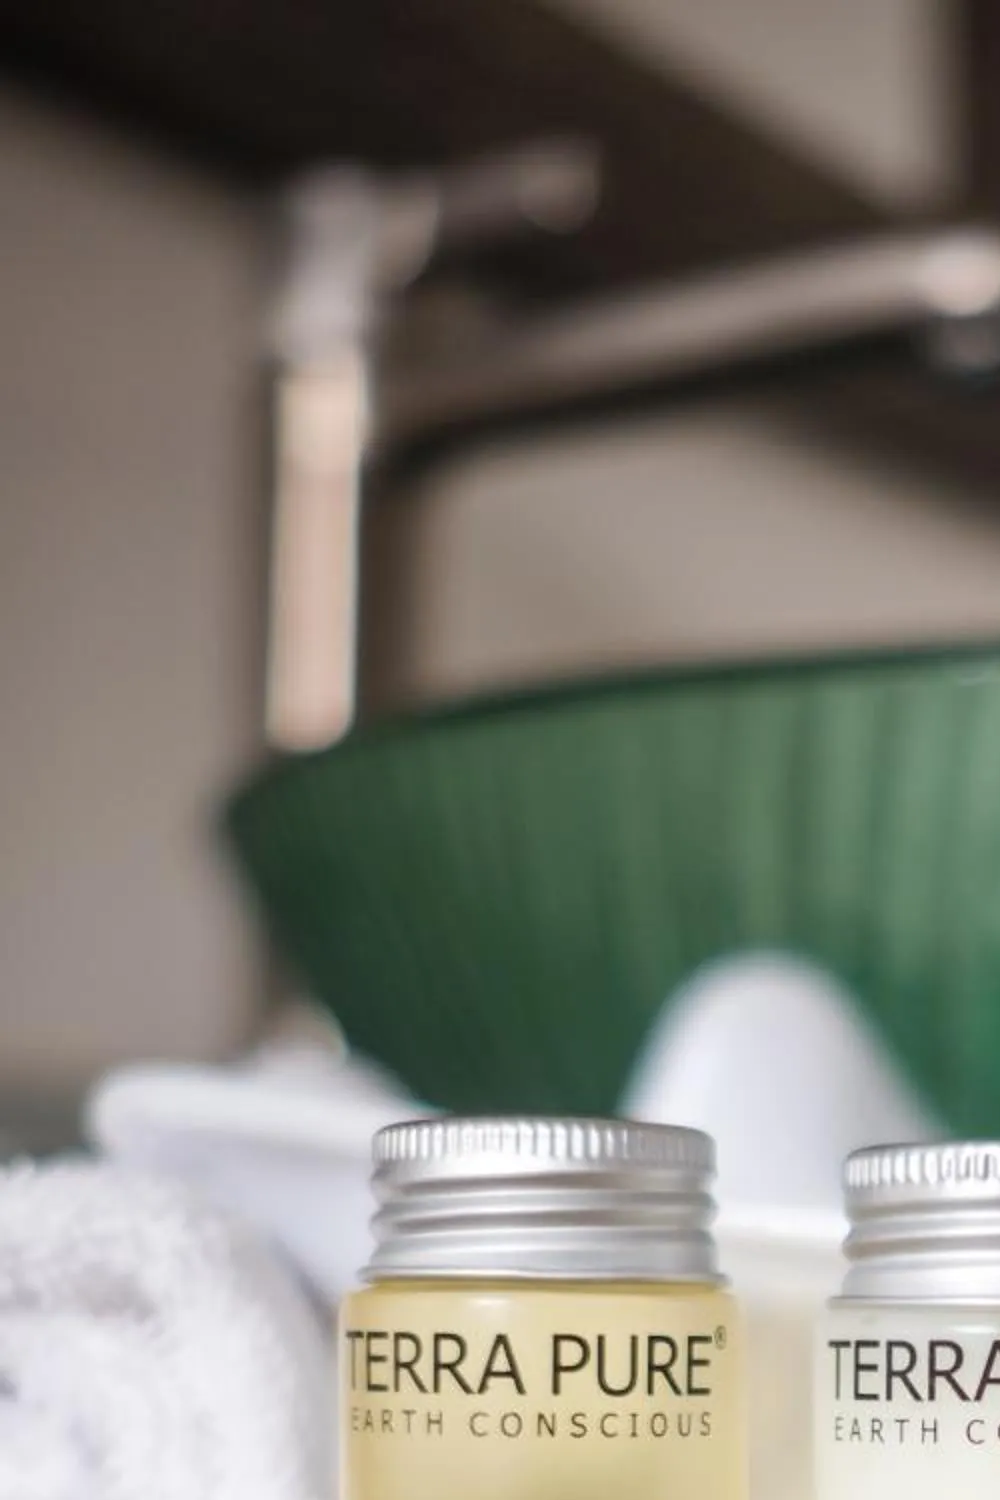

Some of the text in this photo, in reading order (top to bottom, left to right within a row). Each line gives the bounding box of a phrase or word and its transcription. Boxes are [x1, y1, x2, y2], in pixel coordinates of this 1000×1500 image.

[345, 1329, 527, 1397] TERRA
[351, 1406, 712, 1439] EARTH CONSCIOUS
[834, 1417, 939, 1445] EARTH
